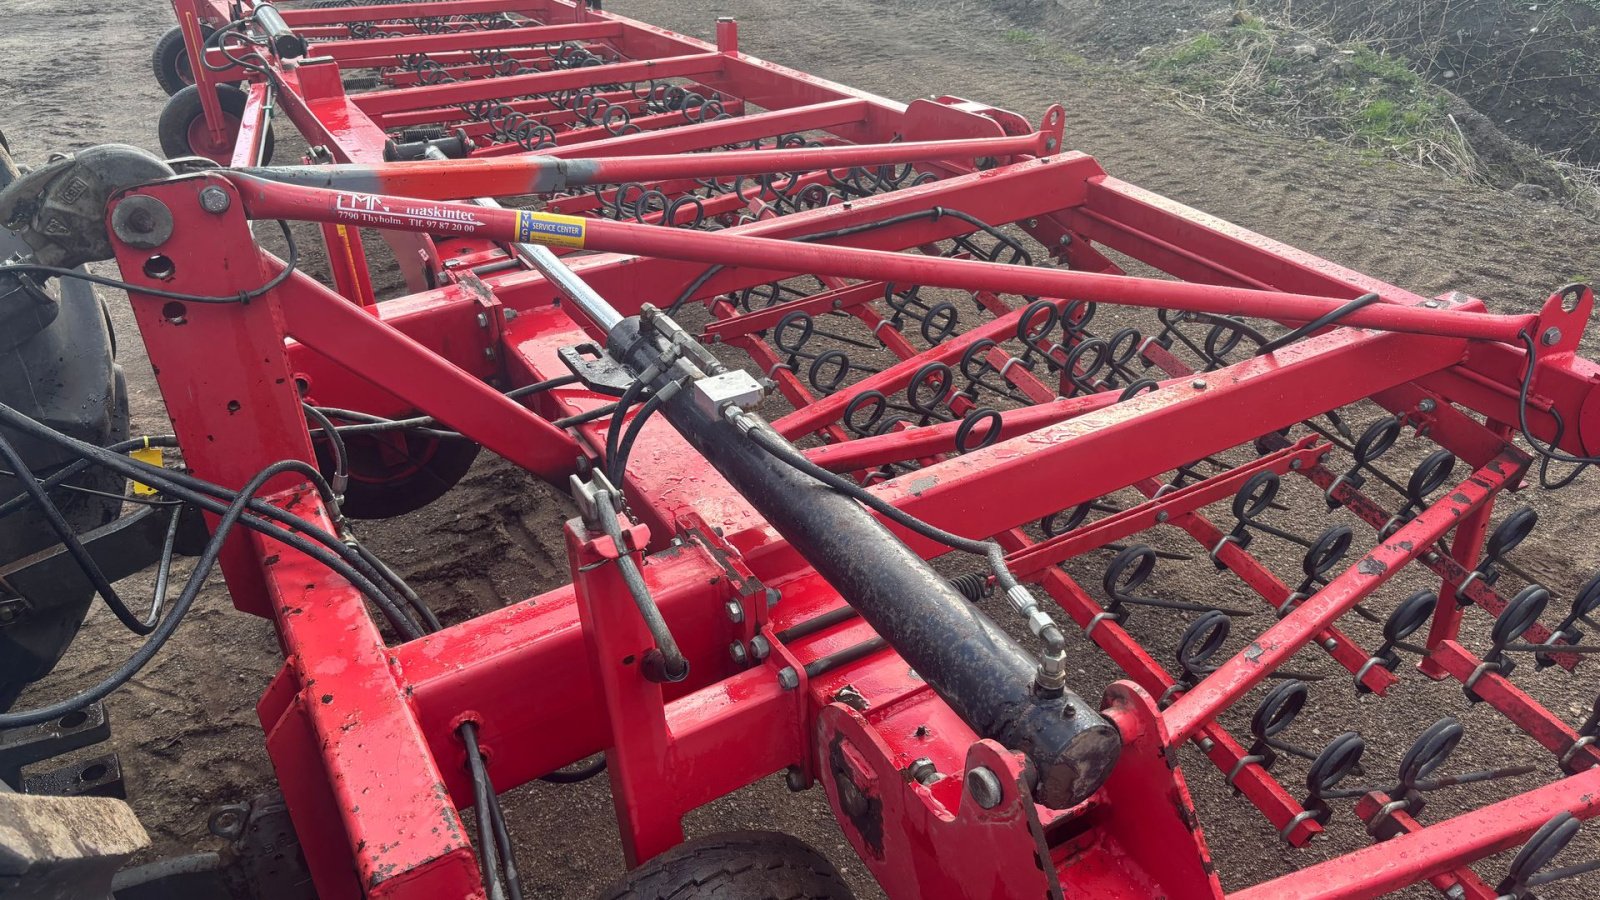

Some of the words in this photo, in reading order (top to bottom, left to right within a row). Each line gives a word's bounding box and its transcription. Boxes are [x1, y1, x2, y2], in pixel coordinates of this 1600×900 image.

[406, 206, 475, 221] maskintec
[338, 211, 359, 220] 7790
[361, 213, 404, 225] Thyholm.
[426, 220, 437, 229] 97
[439, 222, 450, 230] 87
[452, 223, 462, 231] 20
[464, 225, 475, 233] 00
[532, 222, 556, 231] SERVICE
[557, 225, 579, 234] CENTER
